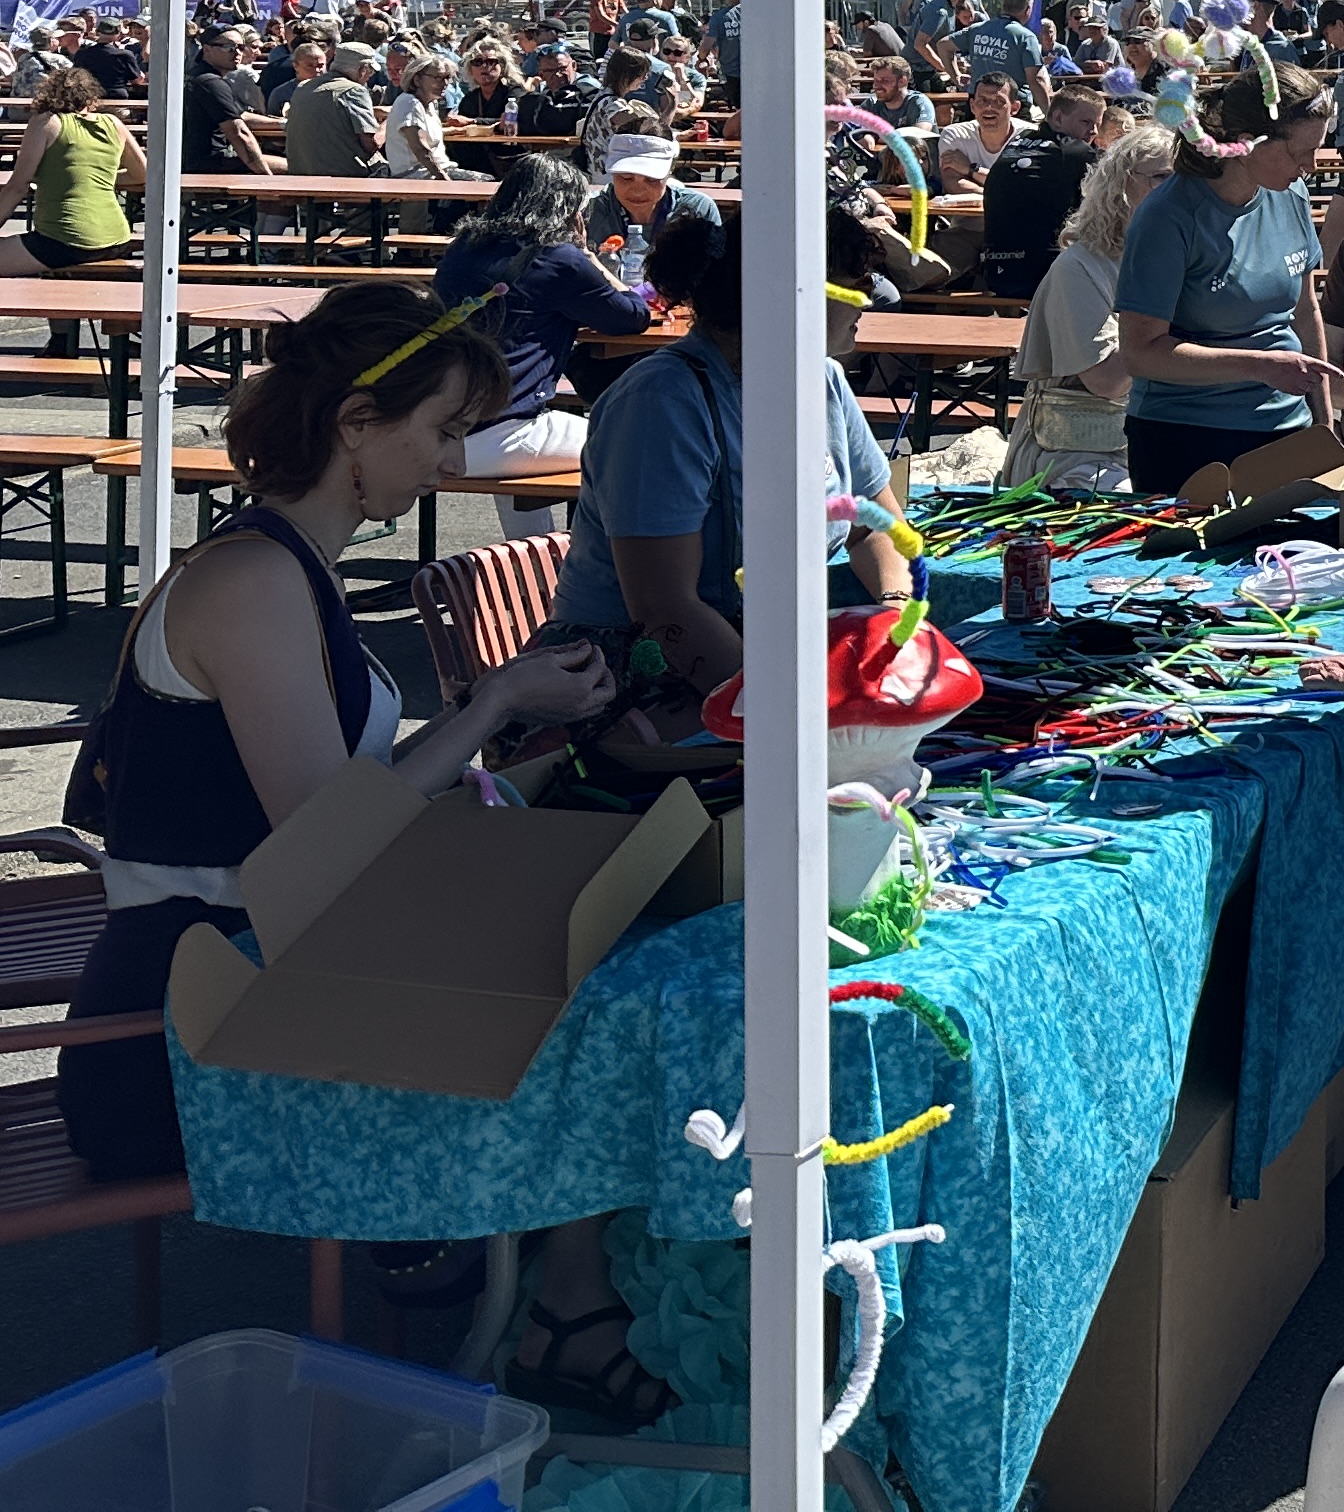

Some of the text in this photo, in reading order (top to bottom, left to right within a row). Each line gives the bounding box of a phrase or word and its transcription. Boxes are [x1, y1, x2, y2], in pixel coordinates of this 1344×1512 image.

[97, 6, 124, 17] UN
[725, 28, 739, 37] RU
[974, 34, 1010, 50] ROYAL
[973, 44, 994, 57] RUN
